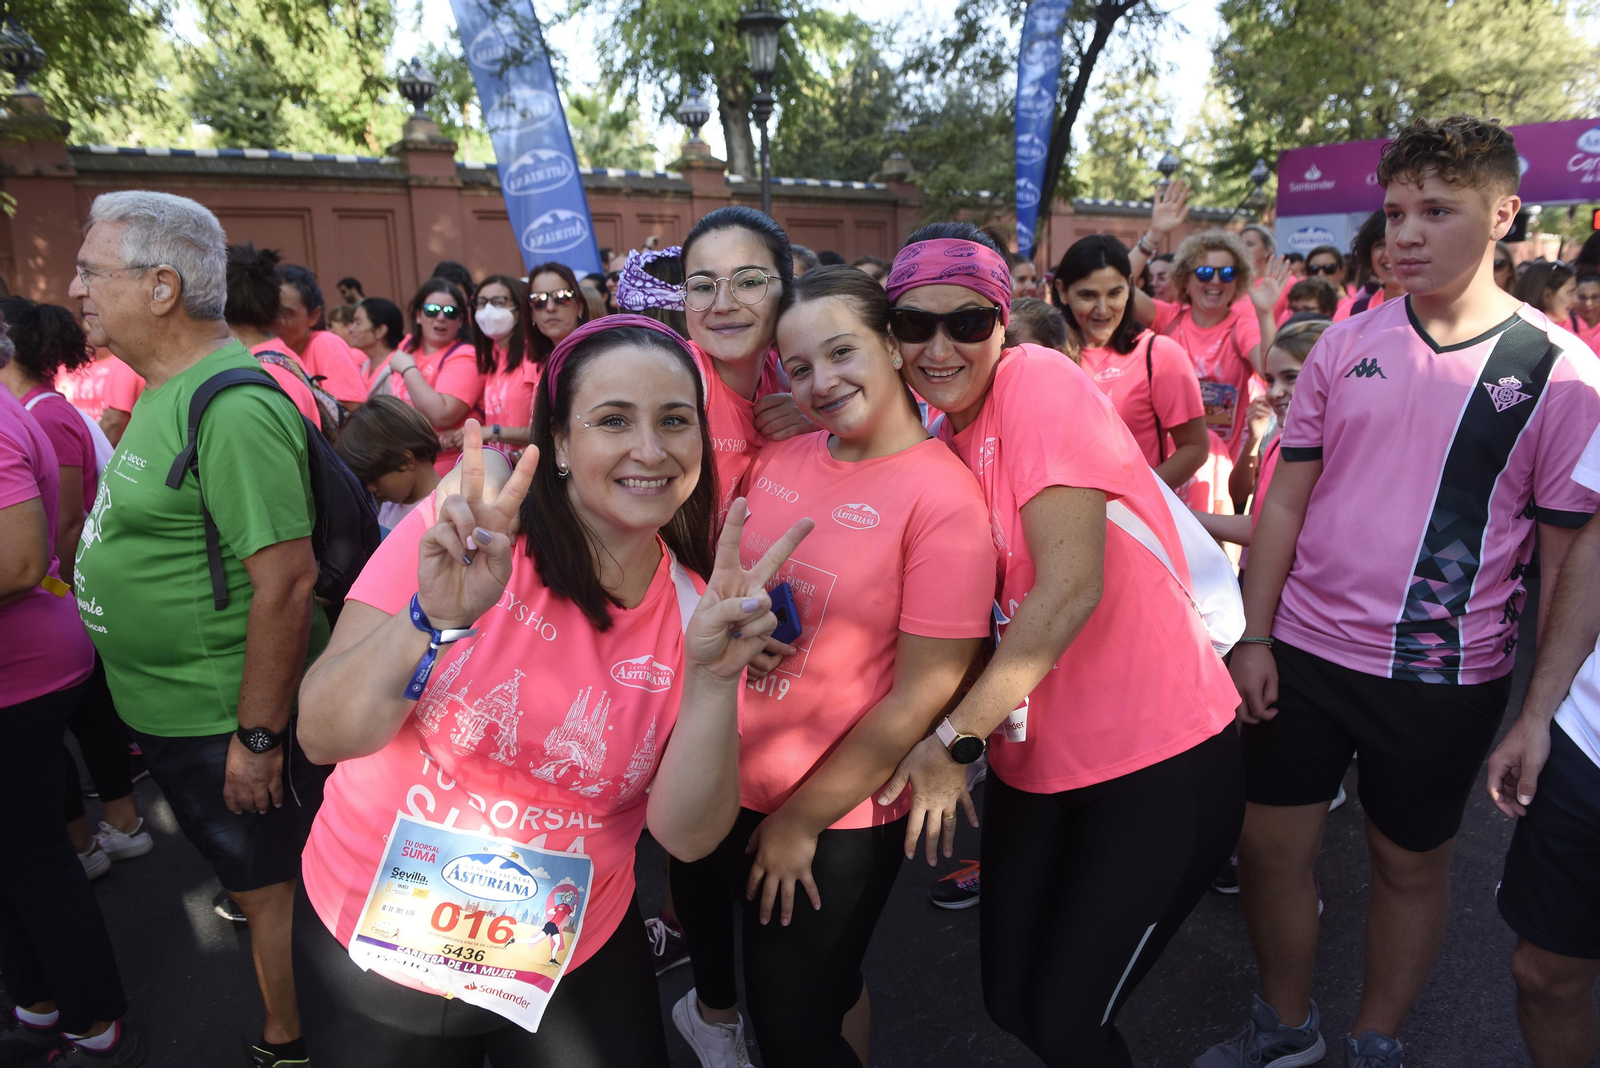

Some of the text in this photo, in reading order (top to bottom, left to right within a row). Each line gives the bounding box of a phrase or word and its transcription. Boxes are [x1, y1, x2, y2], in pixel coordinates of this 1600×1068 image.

[1289, 180, 1336, 193] Santander
[127, 453, 147, 468] aecc
[756, 476, 799, 503] OYSHO
[615, 665, 671, 686] ASTURANA
[401, 846, 437, 864] SUMA
[404, 839, 440, 854] TU DORSAL
[446, 863, 530, 897] ASTURIANA
[430, 901, 518, 945] 016
[396, 945, 517, 979] CARRERA DE LA MUJER
[441, 943, 486, 962] 5436
[478, 984, 532, 1010] Santander
